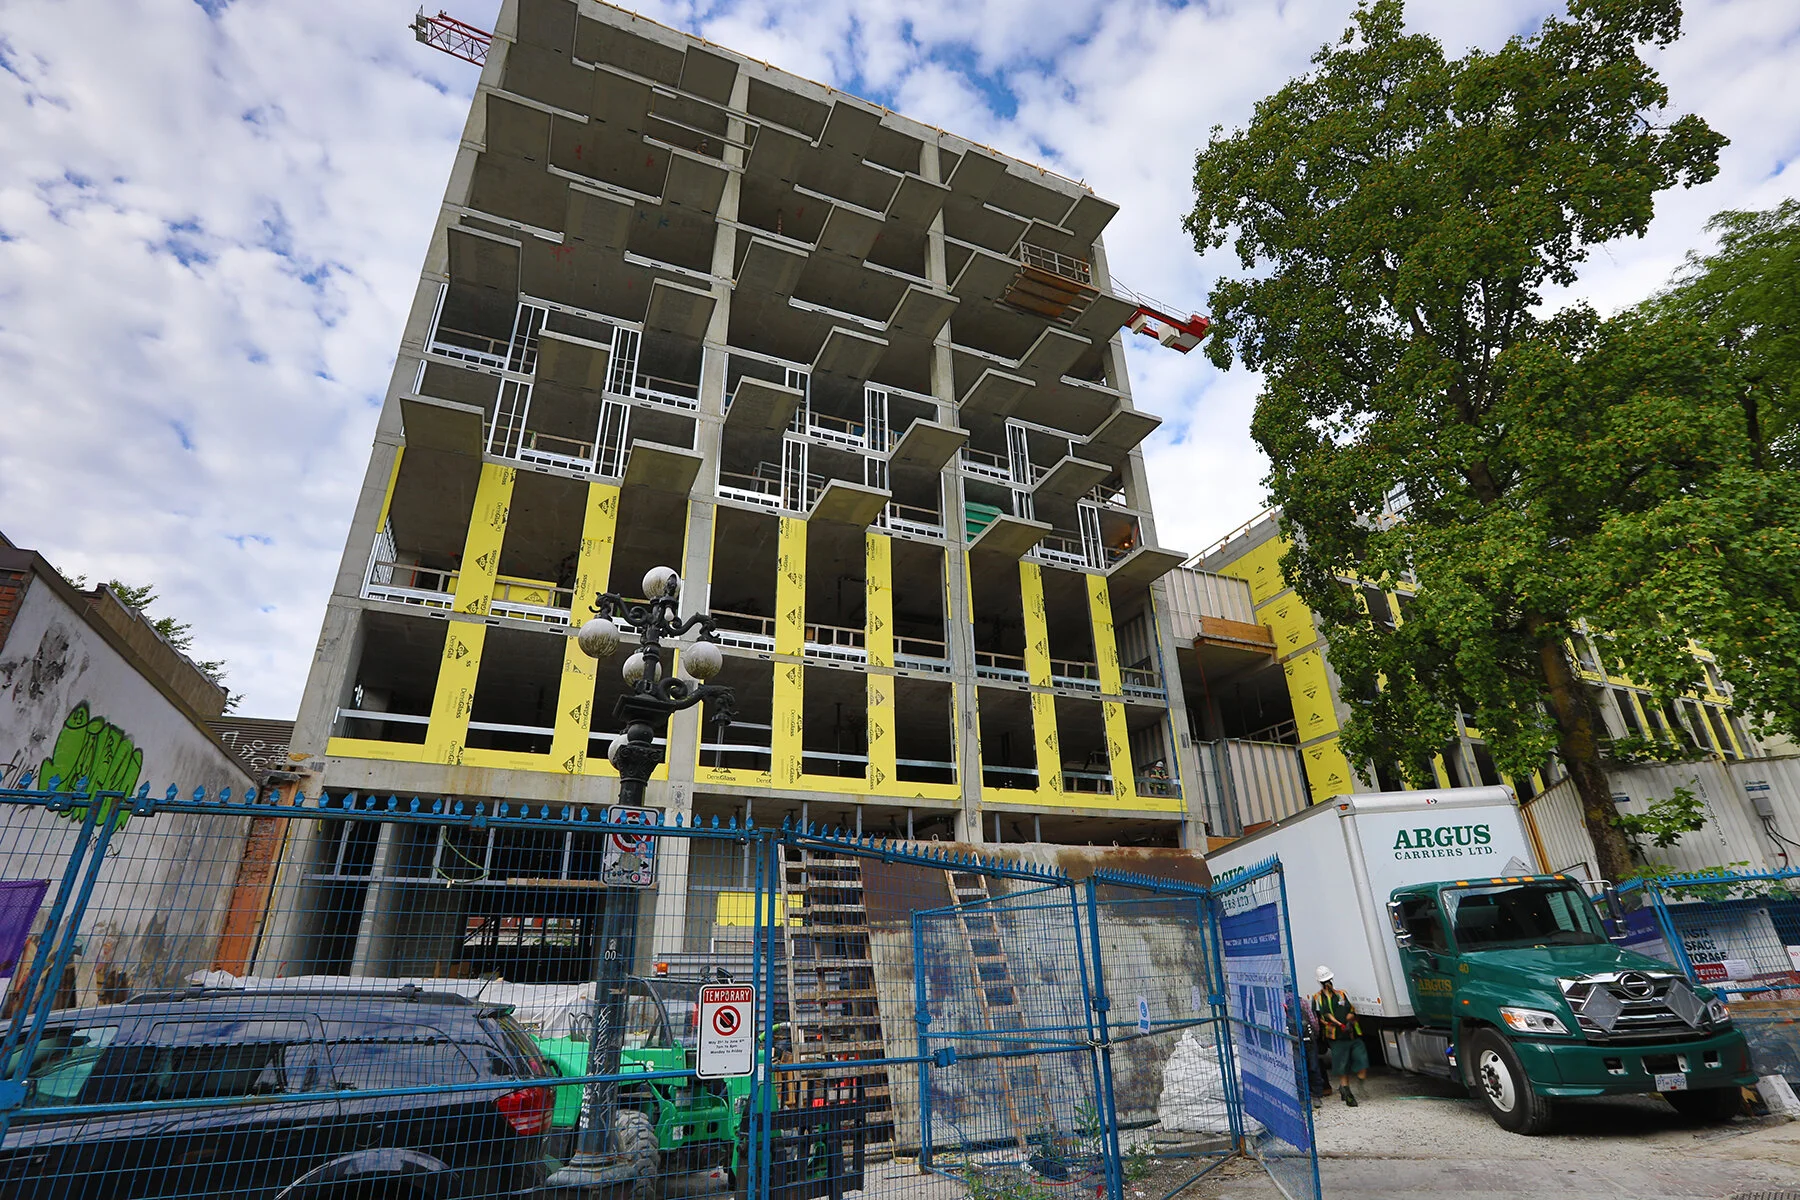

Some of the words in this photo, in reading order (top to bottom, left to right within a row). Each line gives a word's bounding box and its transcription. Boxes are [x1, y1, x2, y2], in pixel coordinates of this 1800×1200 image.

[487, 549, 497, 576] DensGlass
[579, 574, 588, 601] DensGlass
[456, 688, 467, 718] DensGlass
[581, 700, 591, 729] DensGlass
[706, 774, 736, 782] DensGlass
[1393, 824, 1491, 850] ARGUS
[1394, 848, 1463, 860] CARRIERS
[1468, 846, 1497, 856] LTD.
[1688, 952, 1727, 963] TORAGE
[1458, 963, 1469, 974] 40
[1418, 978, 1452, 992] ARGUS
[705, 990, 750, 1002] TEMPORARY
